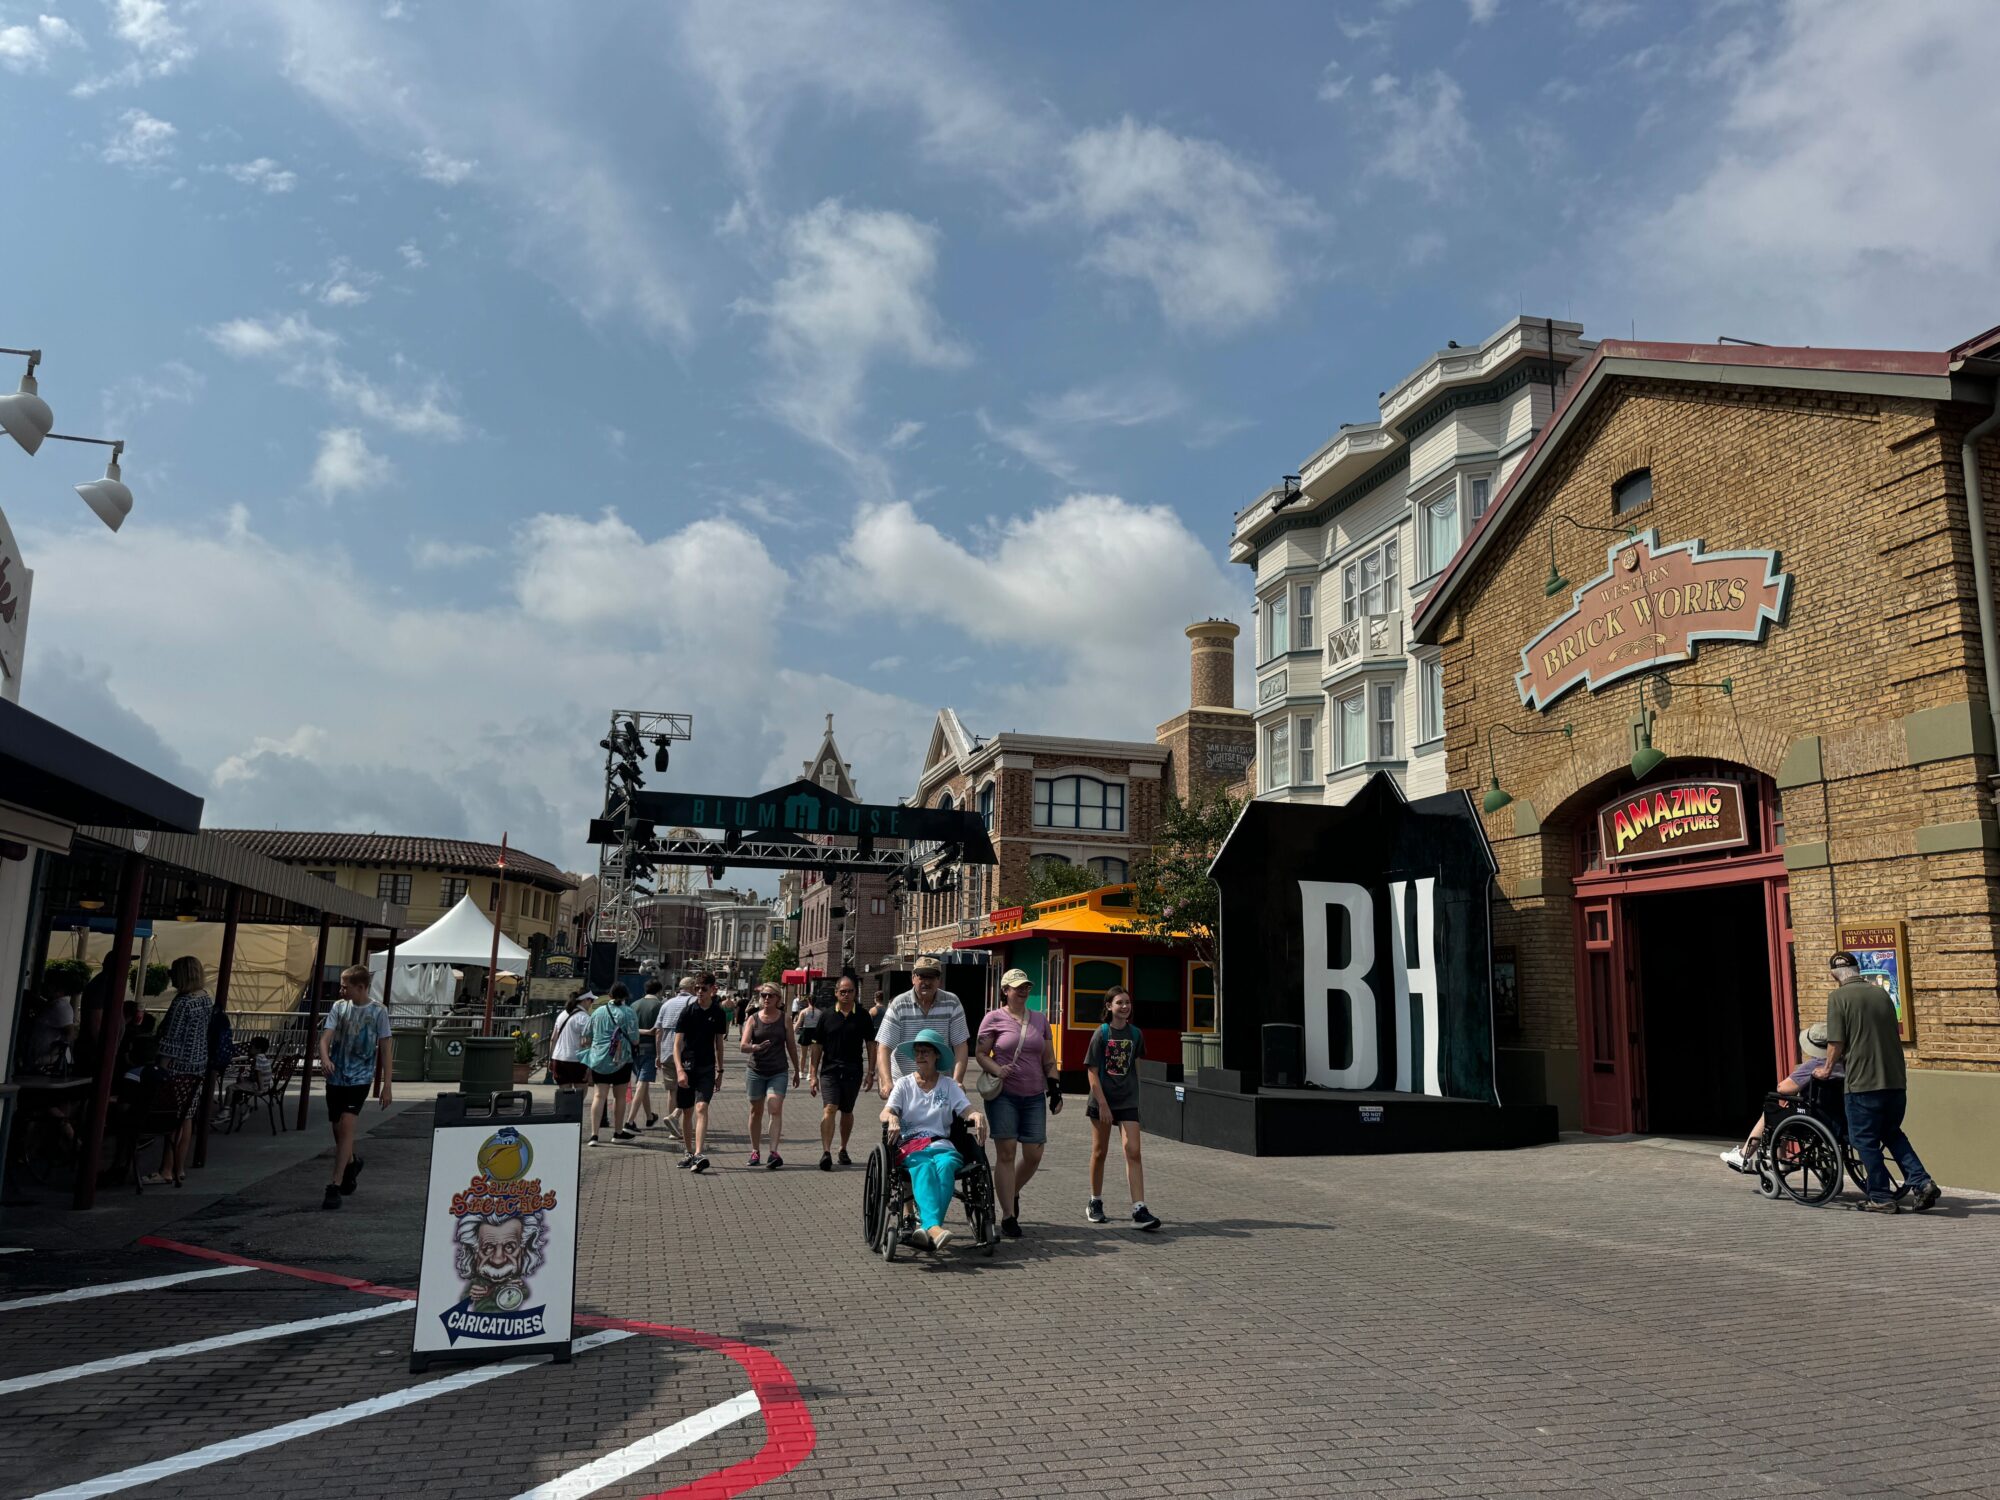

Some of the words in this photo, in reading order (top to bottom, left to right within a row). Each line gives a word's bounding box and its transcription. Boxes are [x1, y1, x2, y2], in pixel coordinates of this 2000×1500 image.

[1600, 563, 1671, 603] WESTERN
[1541, 605, 1625, 680] BRICK
[1630, 577, 1748, 627] WORKS
[1206, 743, 1219, 752] SAN
[1220, 744, 1254, 754] FRANCISCO
[692, 792, 900, 835] BLUMHOUSE
[1614, 788, 1721, 853] AMAZING
[1658, 815, 1720, 843] PICTURES
[1846, 936, 1858, 945] BE
[1860, 935, 1867, 944] A
[1868, 934, 1894, 944] STAR
[1298, 877, 1443, 1097] BH
[447, 1311, 543, 1335] CARICATURES
